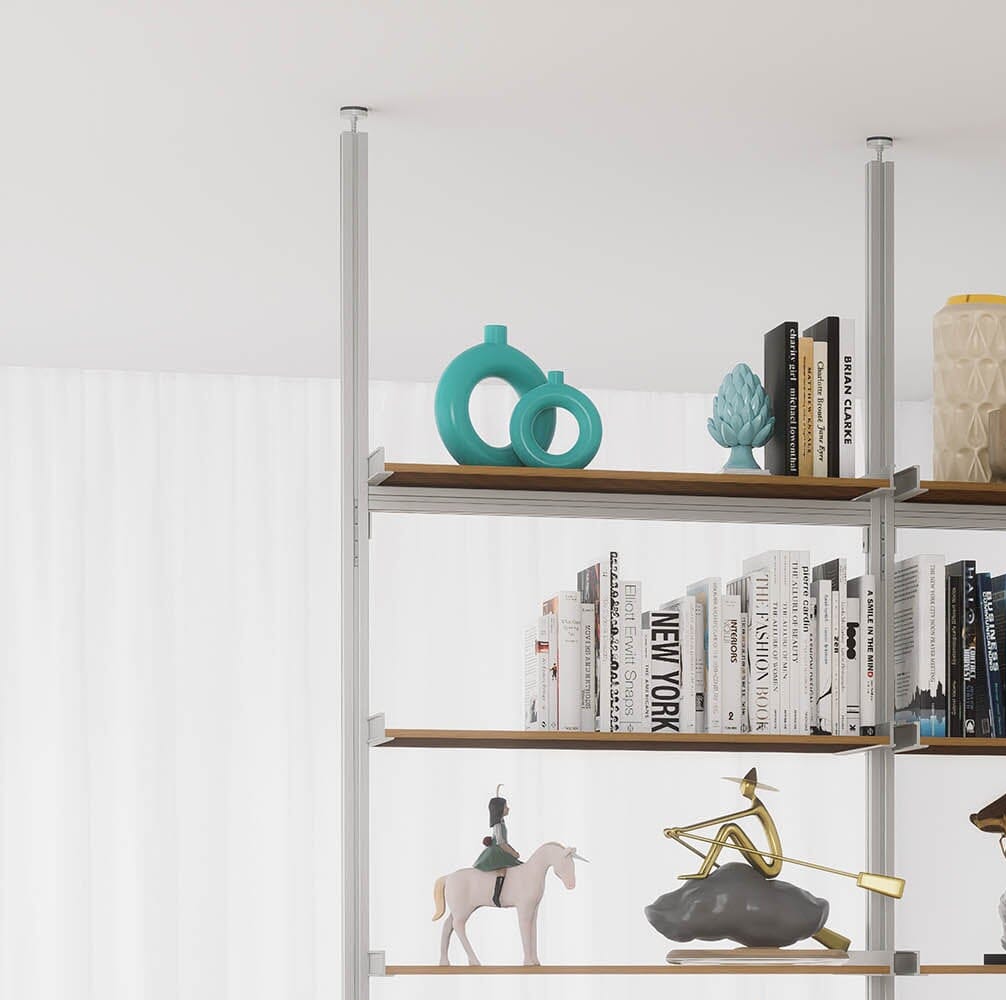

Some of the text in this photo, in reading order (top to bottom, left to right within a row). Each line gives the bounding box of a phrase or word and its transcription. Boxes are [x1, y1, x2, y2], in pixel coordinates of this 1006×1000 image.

[844, 356, 852, 444] BRIAN CLARKE
[801, 566, 809, 597] pierre
[621, 585, 637, 715] Elliott Erwitt Snaps
[755, 575, 769, 731] THE FASHION BOOK
[867, 626, 873, 634] IN
[986, 591, 999, 672] BUSINESS
[652, 613, 679, 732] NEW YORK
[728, 712, 733, 720] 2
